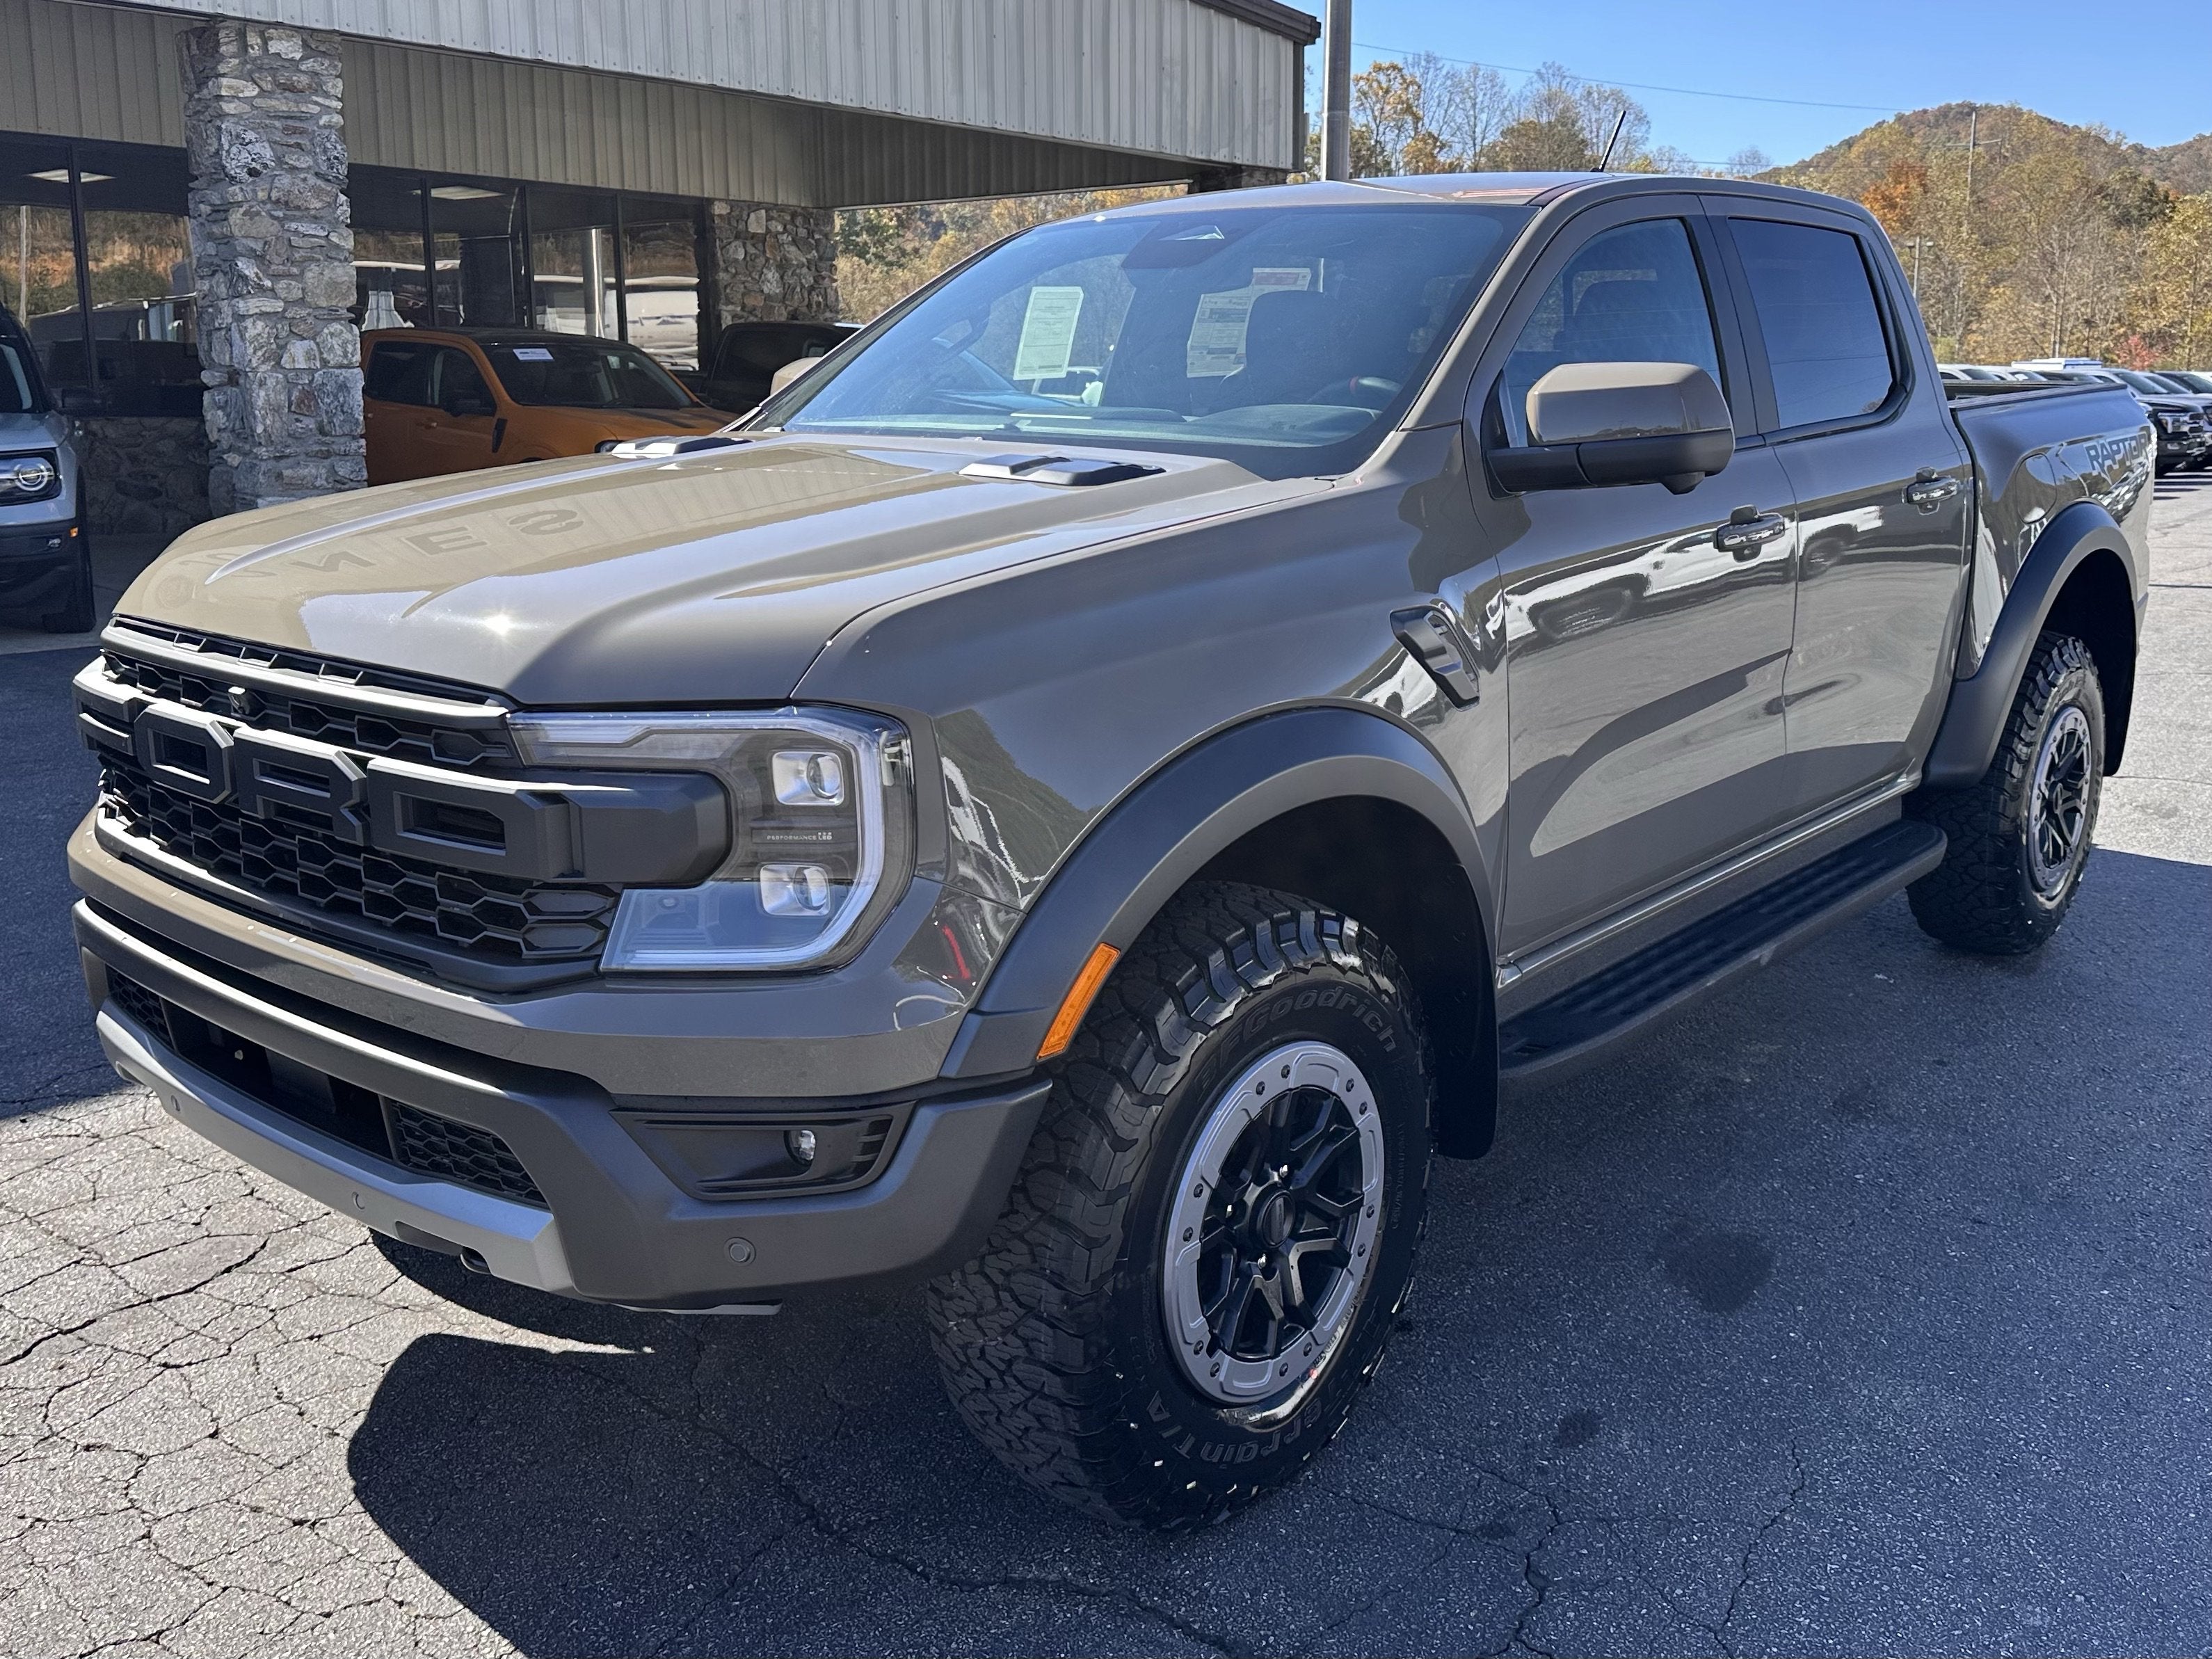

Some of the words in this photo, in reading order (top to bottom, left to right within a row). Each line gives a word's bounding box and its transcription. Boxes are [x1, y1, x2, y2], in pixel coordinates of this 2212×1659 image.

[2083, 431, 2149, 479] RAPTOR
[72, 668, 572, 881] FORD
[1194, 985, 1397, 1102] BFGoodrich
